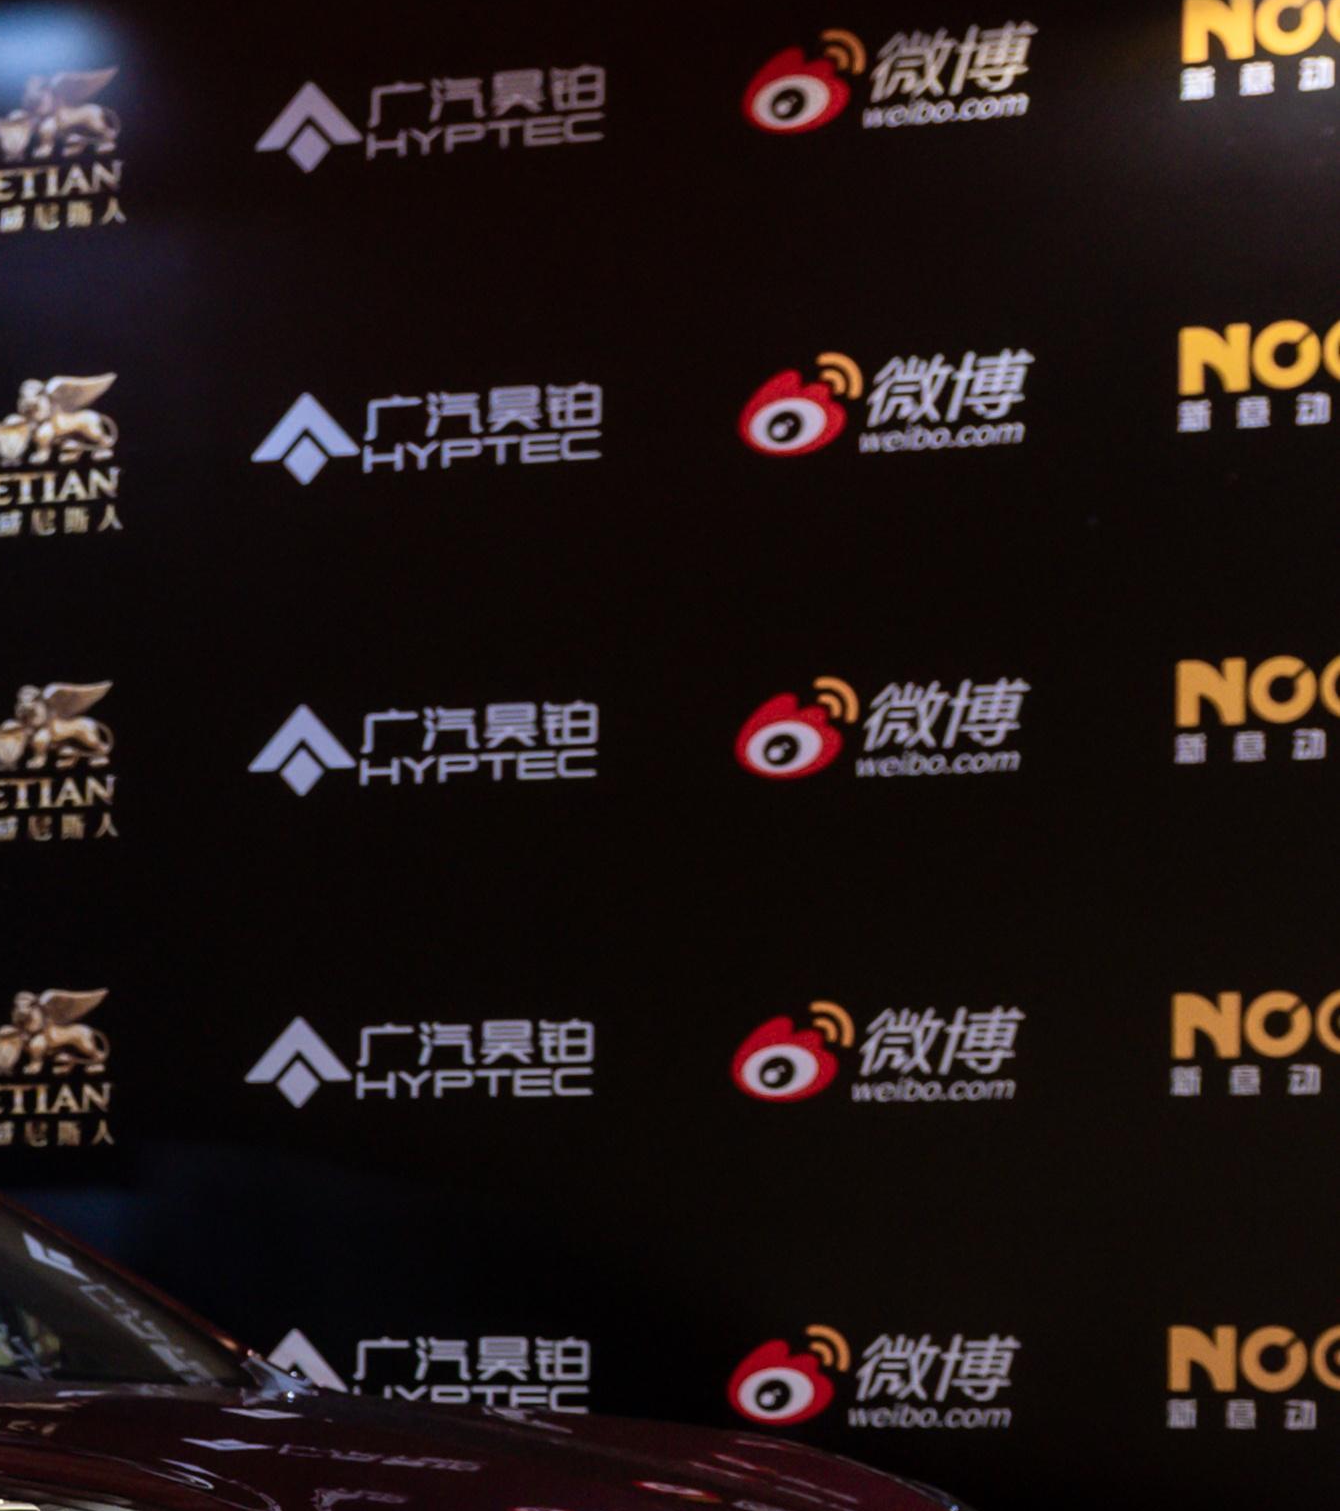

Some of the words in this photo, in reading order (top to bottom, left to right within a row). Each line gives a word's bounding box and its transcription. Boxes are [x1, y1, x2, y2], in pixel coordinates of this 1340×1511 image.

[870, 20, 1038, 103] 微博
[369, 64, 606, 129] 广汽昊铂
[862, 92, 1030, 129] weibo.com
[366, 111, 605, 160] HYPTEC
[1178, 319, 1340, 396] NO
[365, 382, 602, 442] 广汽昊铂
[866, 348, 1034, 428] 微博
[363, 430, 601, 474] HYPTEC
[858, 420, 1026, 454] weibo.com
[863, 676, 1030, 752] 微博
[1175, 654, 1340, 728] NO
[361, 700, 598, 755] 广汽昊铂
[360, 748, 597, 787] HYPTEC
[855, 748, 1021, 778] weibo.com
[357, 1018, 595, 1068] 广汽昊铂
[860, 1005, 1025, 1077] 微博
[356, 1066, 593, 1100] HYPTEC
[852, 1075, 1016, 1103] weibo.com
[353, 1336, 591, 1381] 广汽昊铂
[856, 1333, 1021, 1402] 微博
[848, 1403, 1012, 1428] weibo.com
